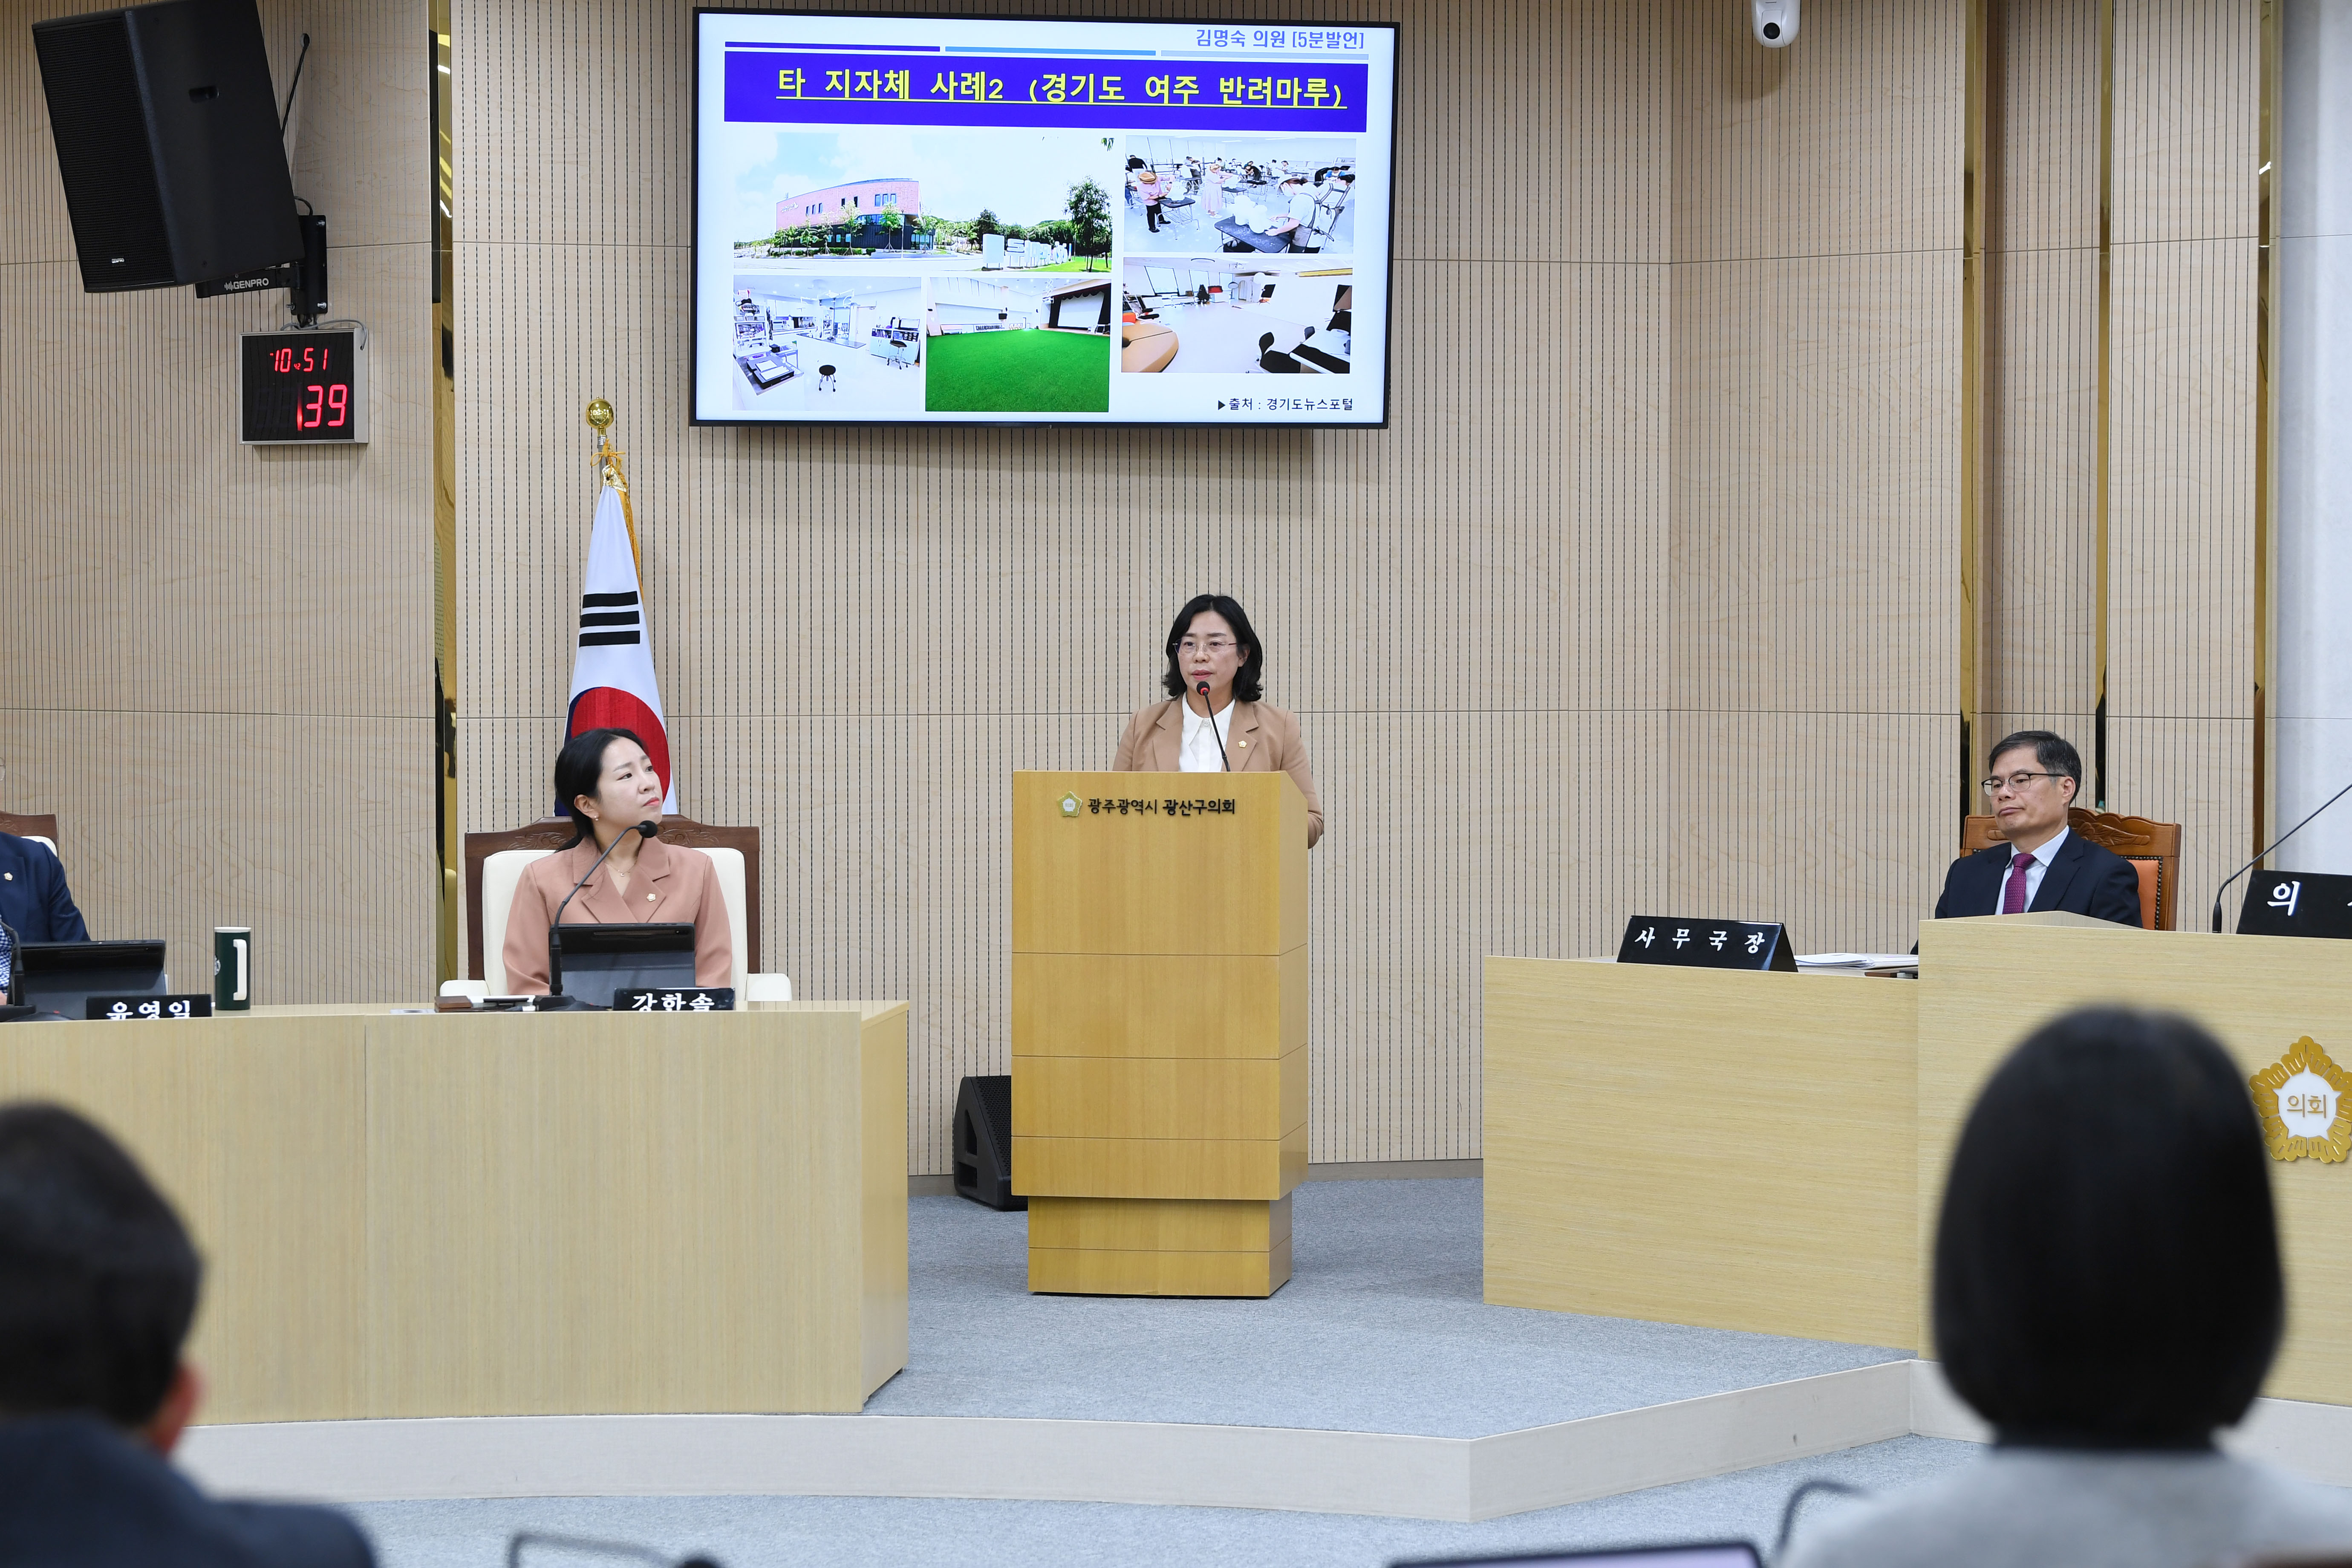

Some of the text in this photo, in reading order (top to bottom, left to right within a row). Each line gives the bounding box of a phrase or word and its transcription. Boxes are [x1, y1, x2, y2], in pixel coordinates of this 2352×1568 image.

[1196, 29, 1364, 49] 김명숙 의원 [5분발언]
[779, 68, 1342, 107] 타 지자체 사례2 (경기도 여주 반려마루)
[233, 277, 269, 289] GENPRO
[1229, 398, 1252, 411] 출처
[1267, 398, 1353, 411] 경기도뉴스포털
[1088, 798, 1235, 816] 광주광역시 광산구의회
[2287, 1094, 2326, 1118] 의회
